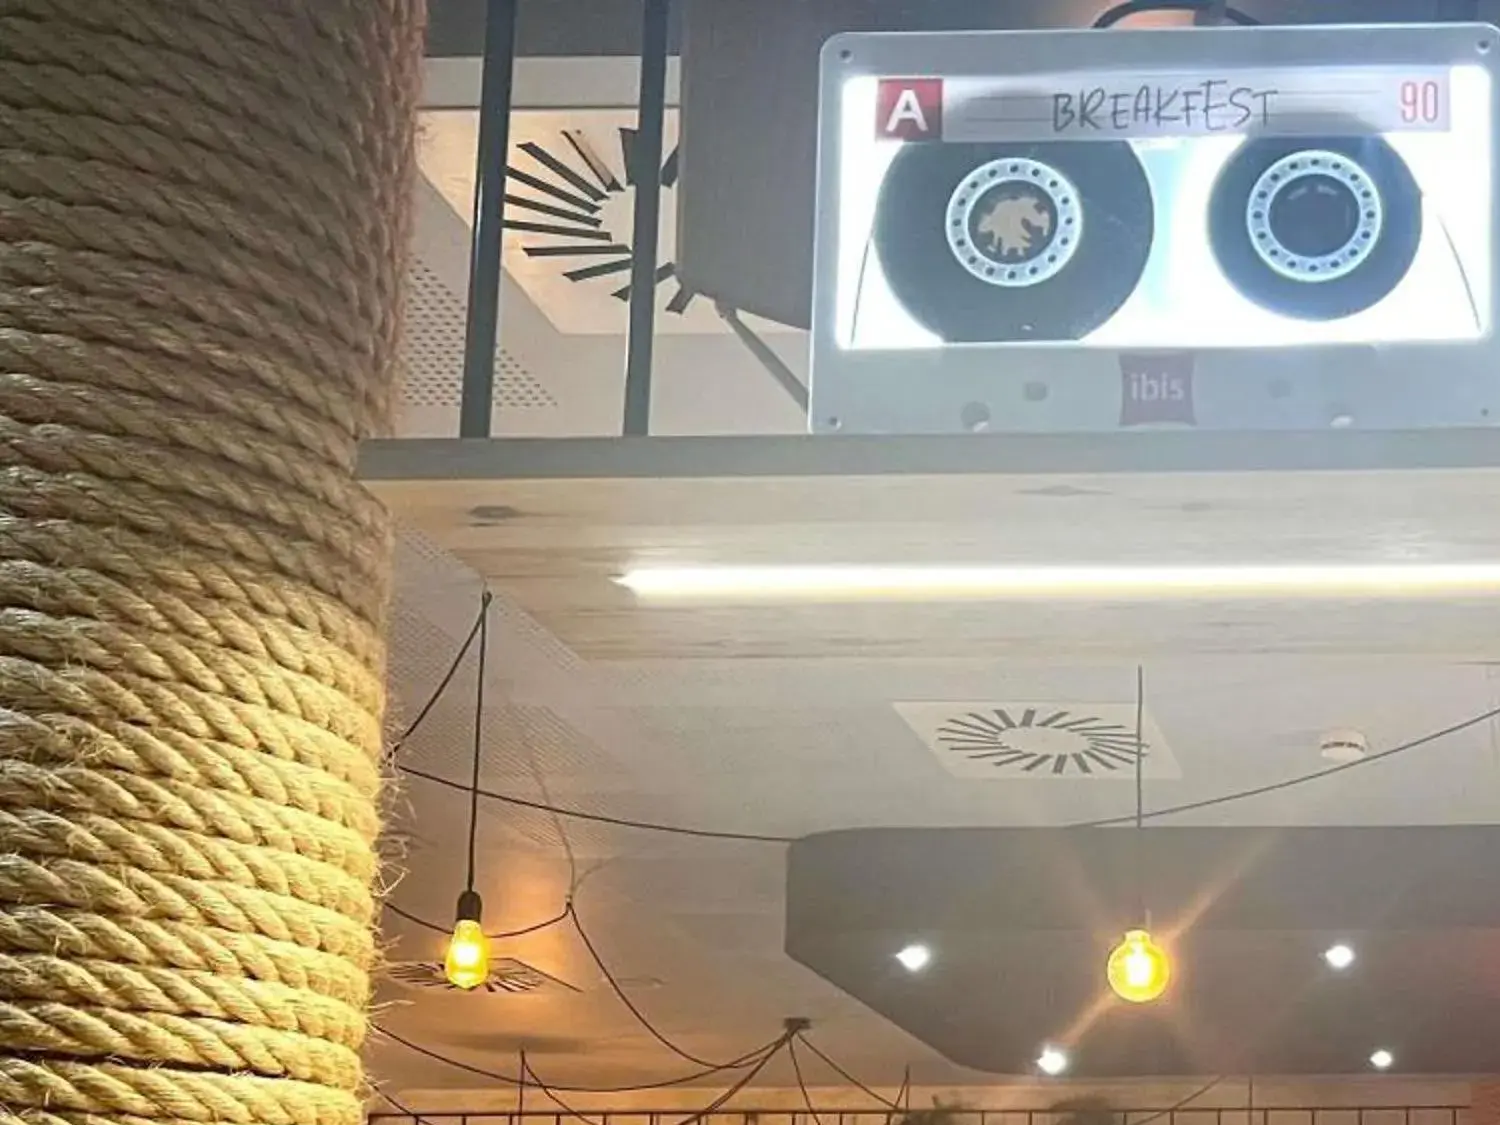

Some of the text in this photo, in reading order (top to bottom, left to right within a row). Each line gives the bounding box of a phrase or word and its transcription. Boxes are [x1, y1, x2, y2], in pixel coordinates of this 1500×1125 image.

[885, 90, 929, 132] A
[1052, 80, 1278, 132] BREAKFEST
[1400, 82, 1439, 124] 90
[1129, 356, 1185, 402] ibis
